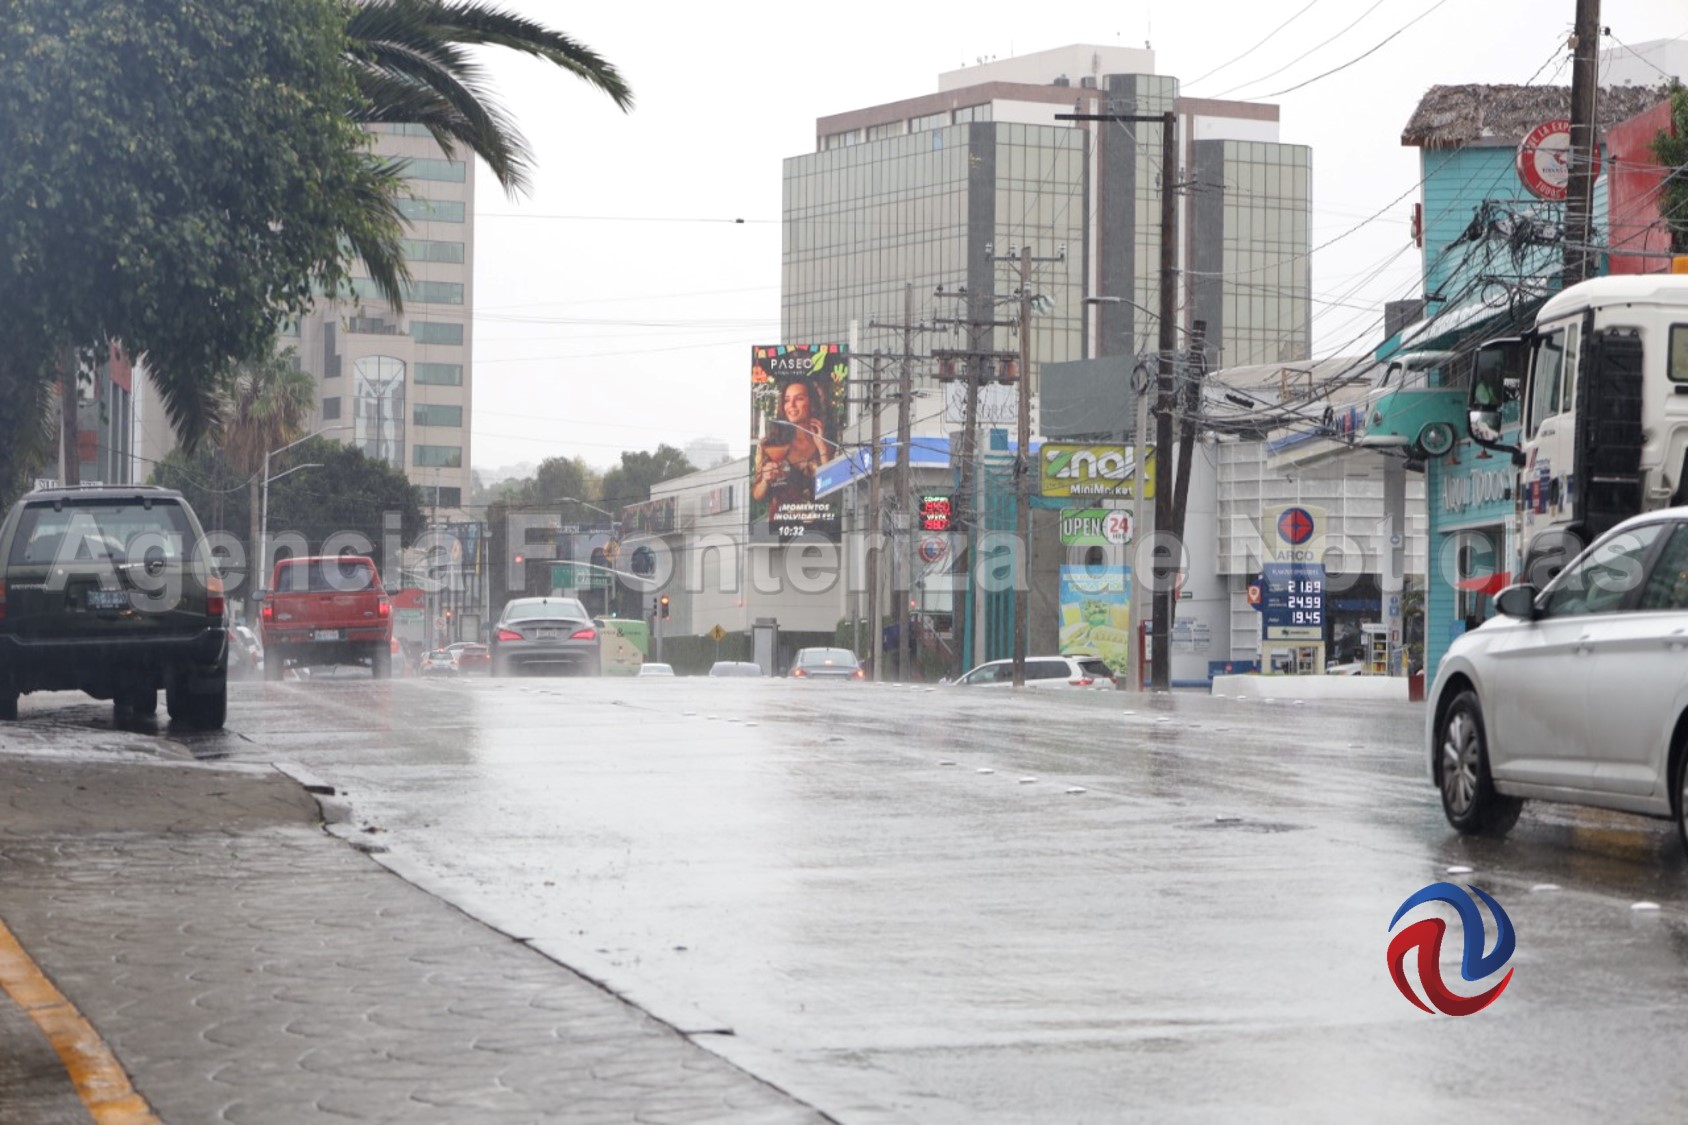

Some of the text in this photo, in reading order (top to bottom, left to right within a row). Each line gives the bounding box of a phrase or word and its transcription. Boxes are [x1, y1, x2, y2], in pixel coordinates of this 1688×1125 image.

[771, 359, 812, 369] PASEO
[778, 526, 805, 536] 10:32
[1064, 517, 1129, 537] OPEN 24
[1277, 550, 1314, 561] ARCO
[1288, 581, 1320, 593] 21.89
[1288, 596, 1320, 609] 24.99
[1291, 611, 1320, 624] 19.45
